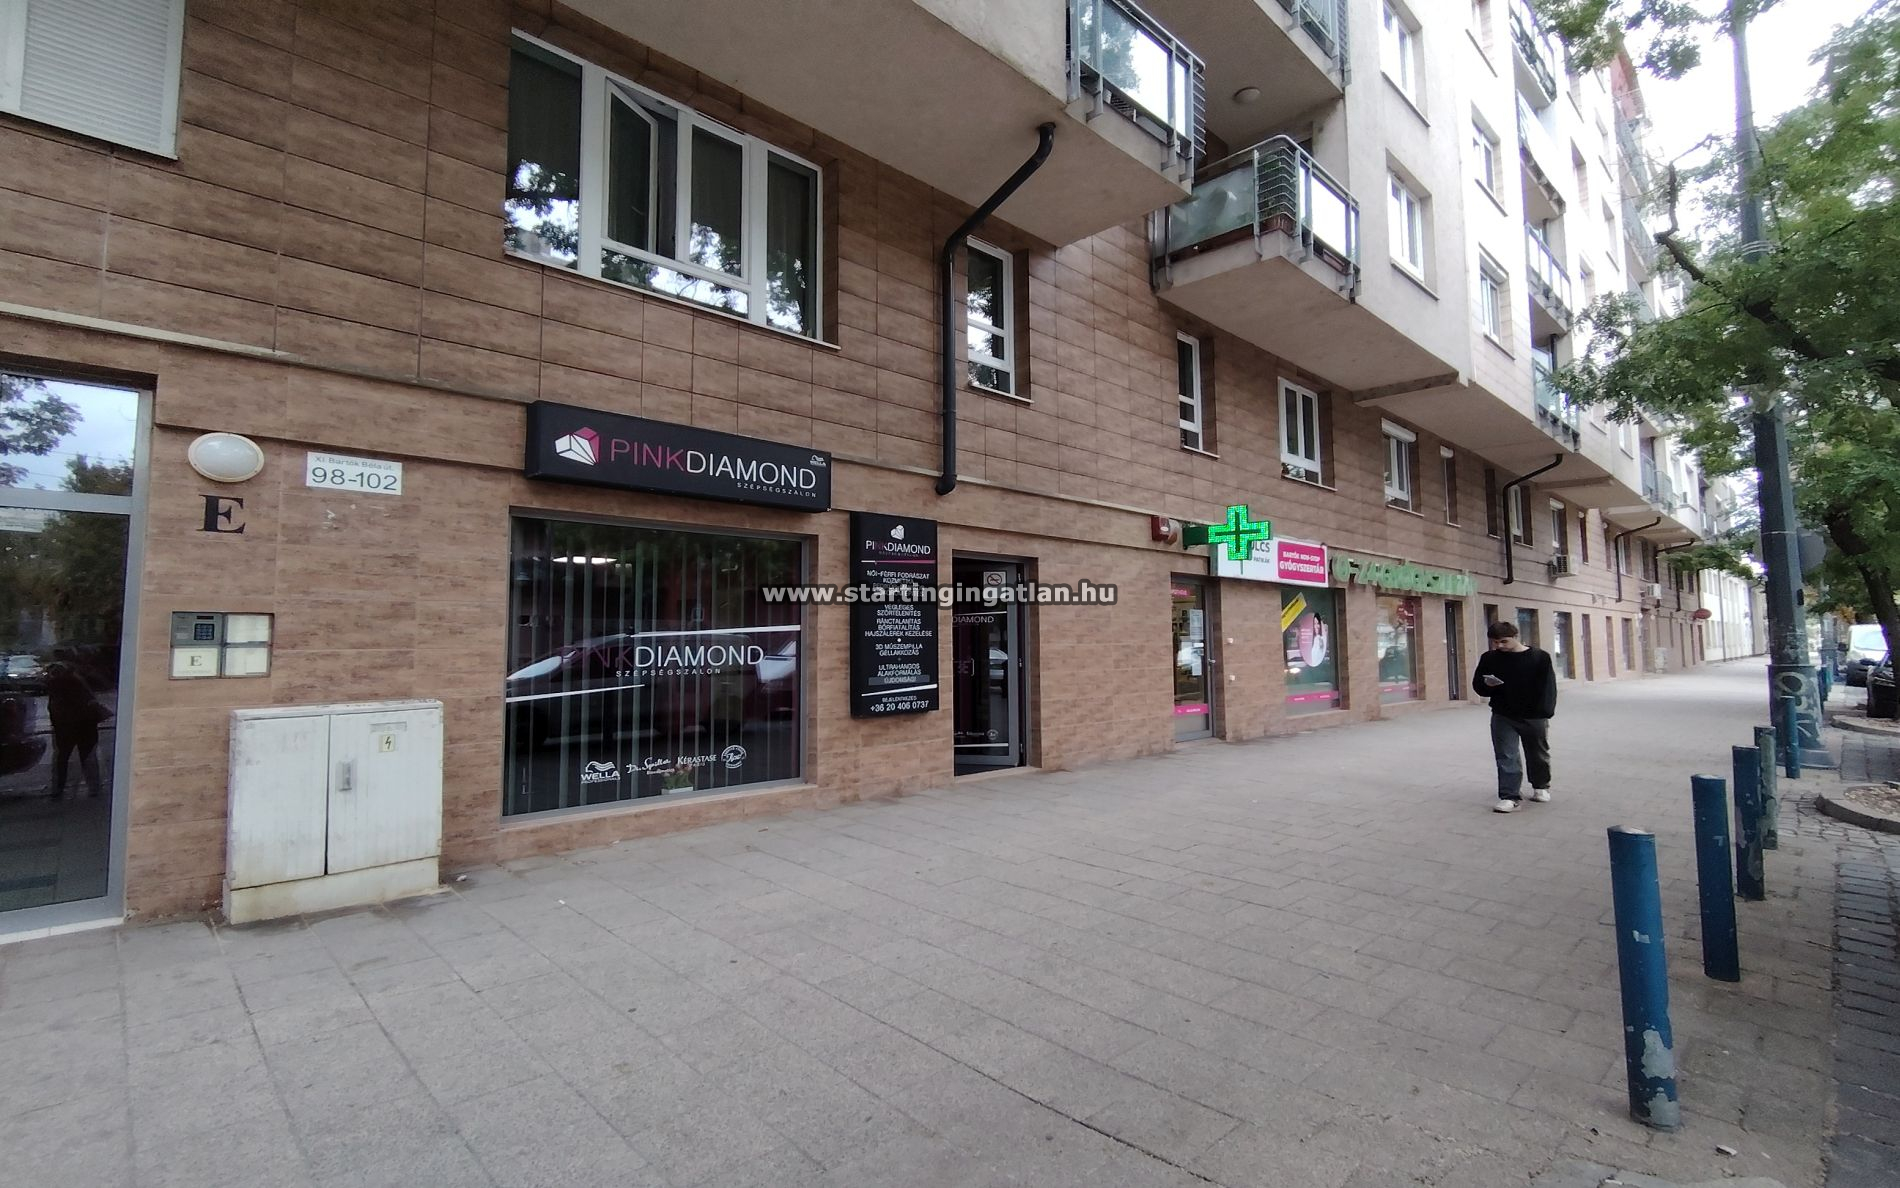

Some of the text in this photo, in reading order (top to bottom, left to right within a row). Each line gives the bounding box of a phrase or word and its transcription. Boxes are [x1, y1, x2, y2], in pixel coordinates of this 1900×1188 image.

[610, 438, 817, 489] PINKDIAMOND
[312, 467, 398, 490] 98-102
[737, 482, 817, 498] SZÉPSÉGSZALON
[196, 494, 247, 535] E
[865, 540, 931, 555] PIKDIAMOND
[190, 655, 202, 666] E
[886, 703, 896, 711] 20
[912, 700, 929, 709] 0737
[581, 770, 620, 781] WELLA
